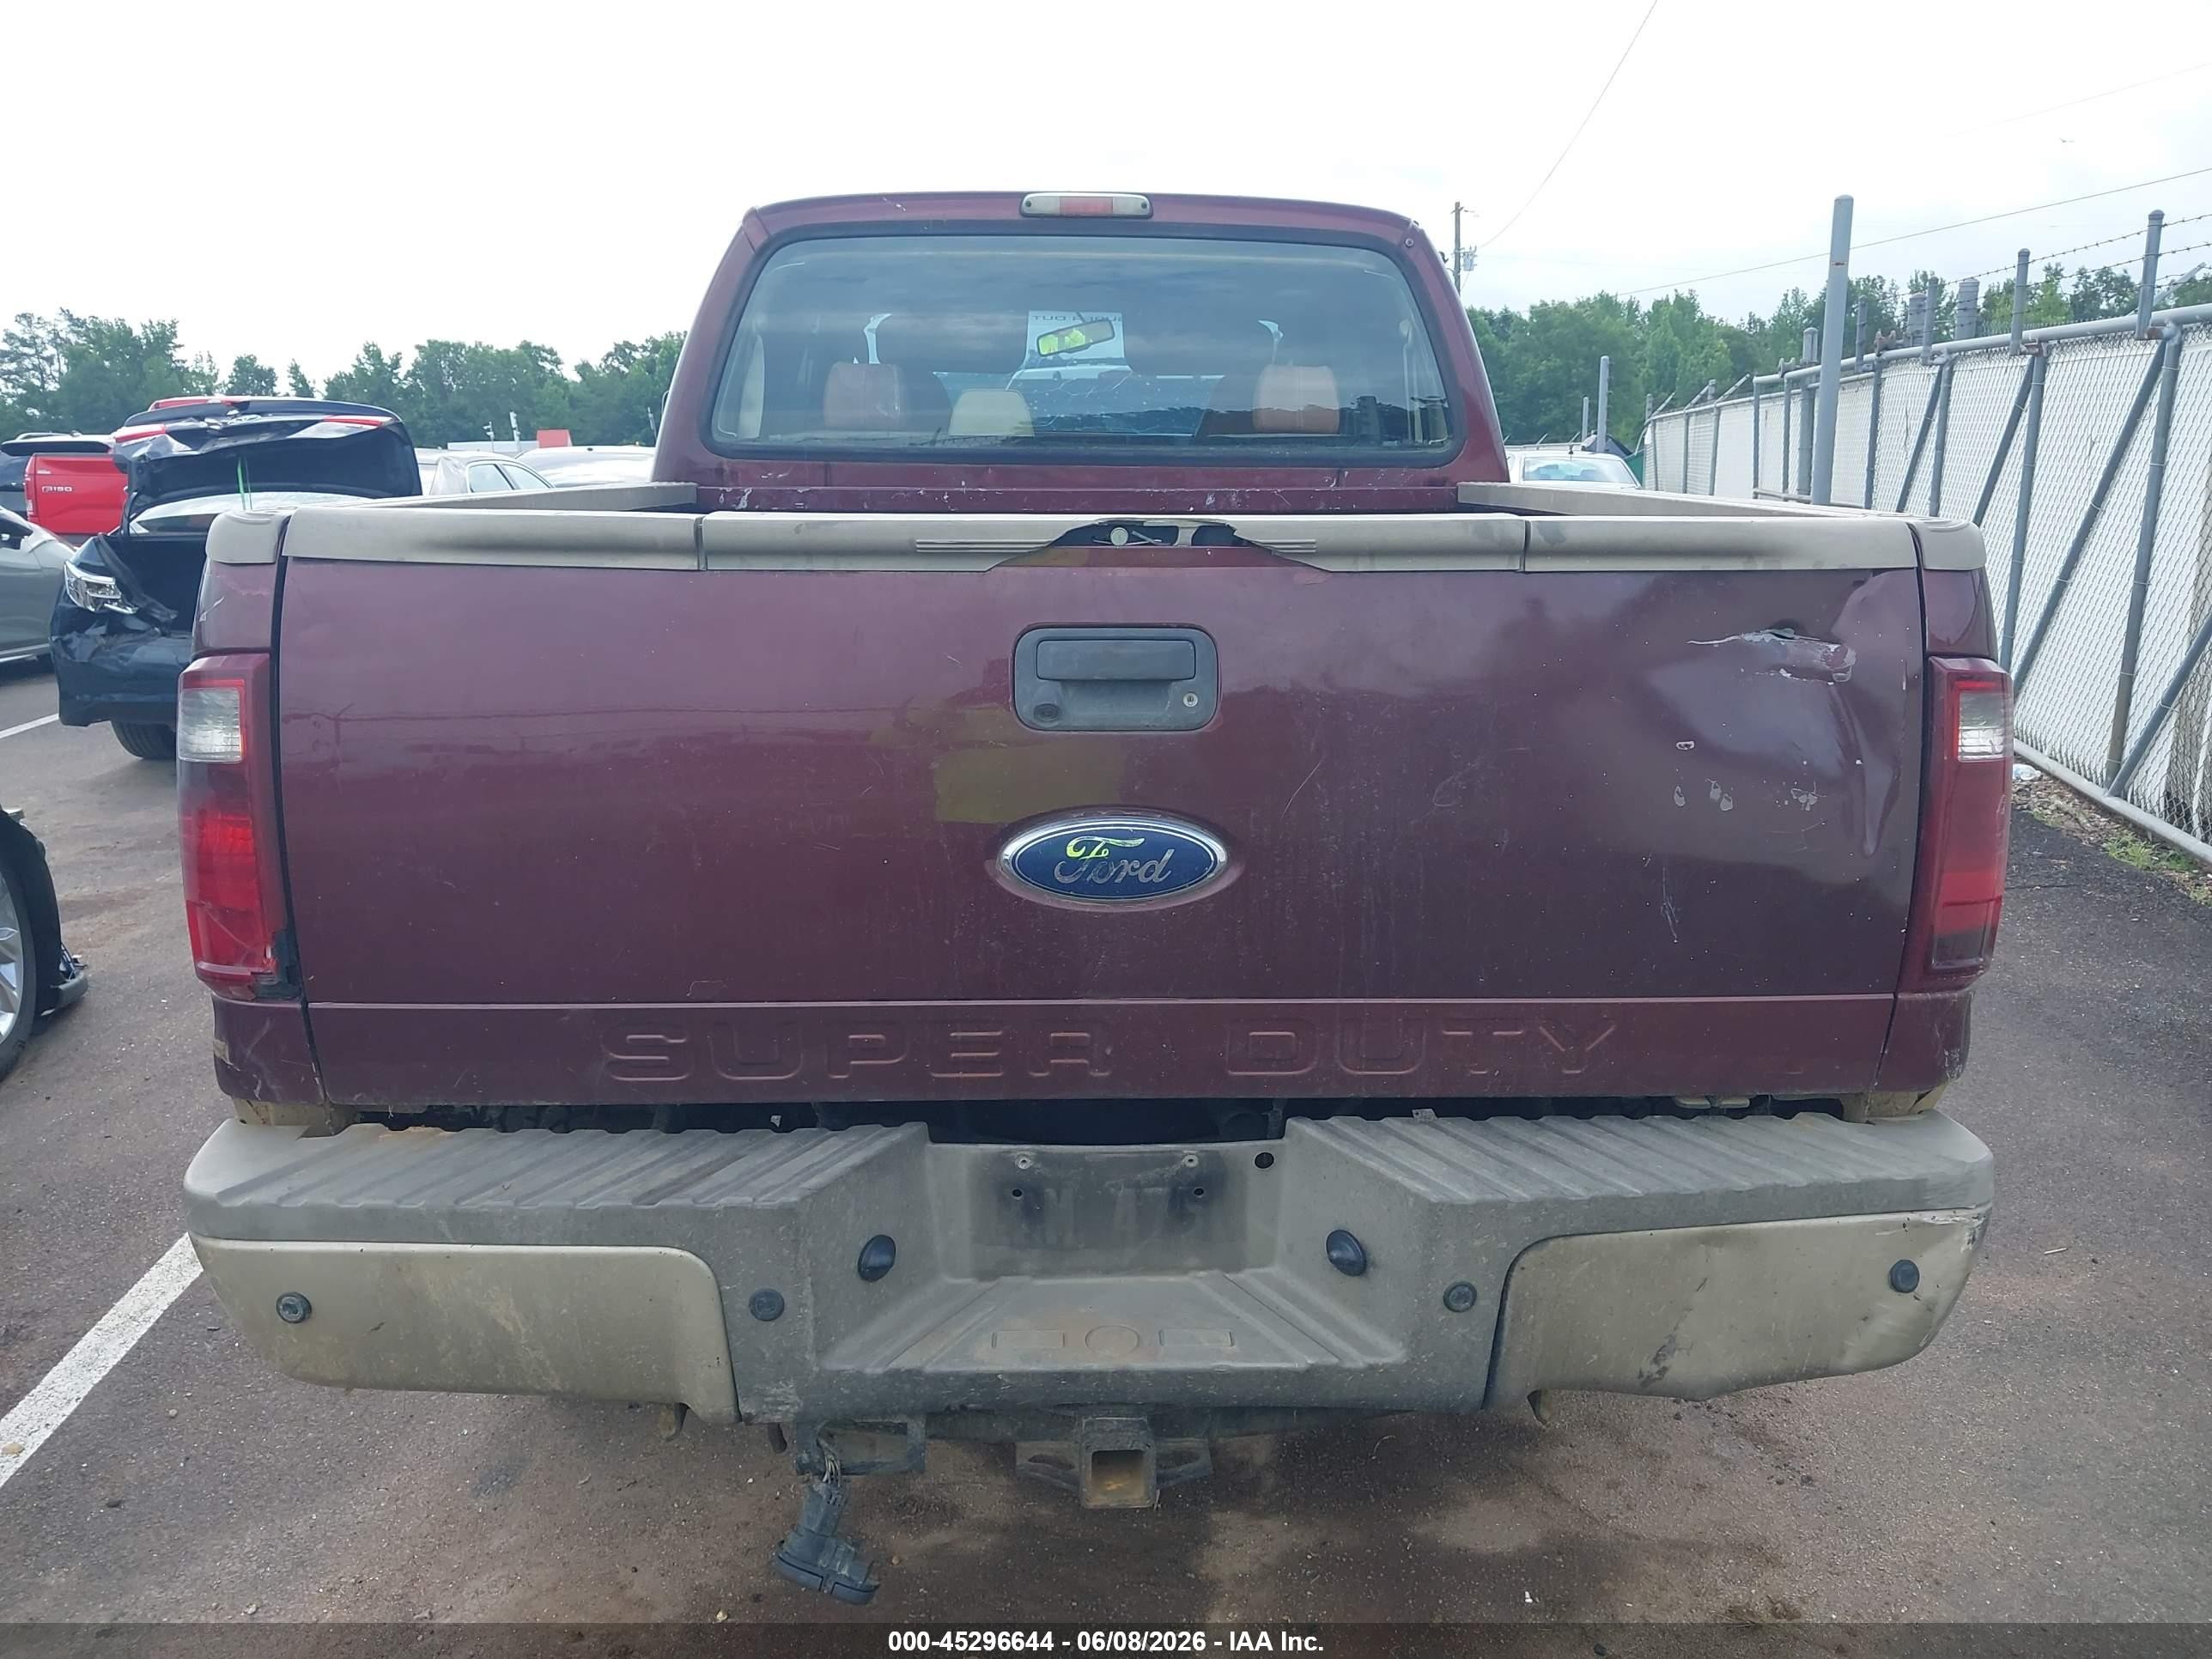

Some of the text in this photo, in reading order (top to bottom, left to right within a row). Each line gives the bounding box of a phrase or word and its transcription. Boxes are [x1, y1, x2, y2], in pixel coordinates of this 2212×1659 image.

[1054, 836, 1175, 884] Ford
[601, 1018, 1618, 1082] SUPER DUTY
